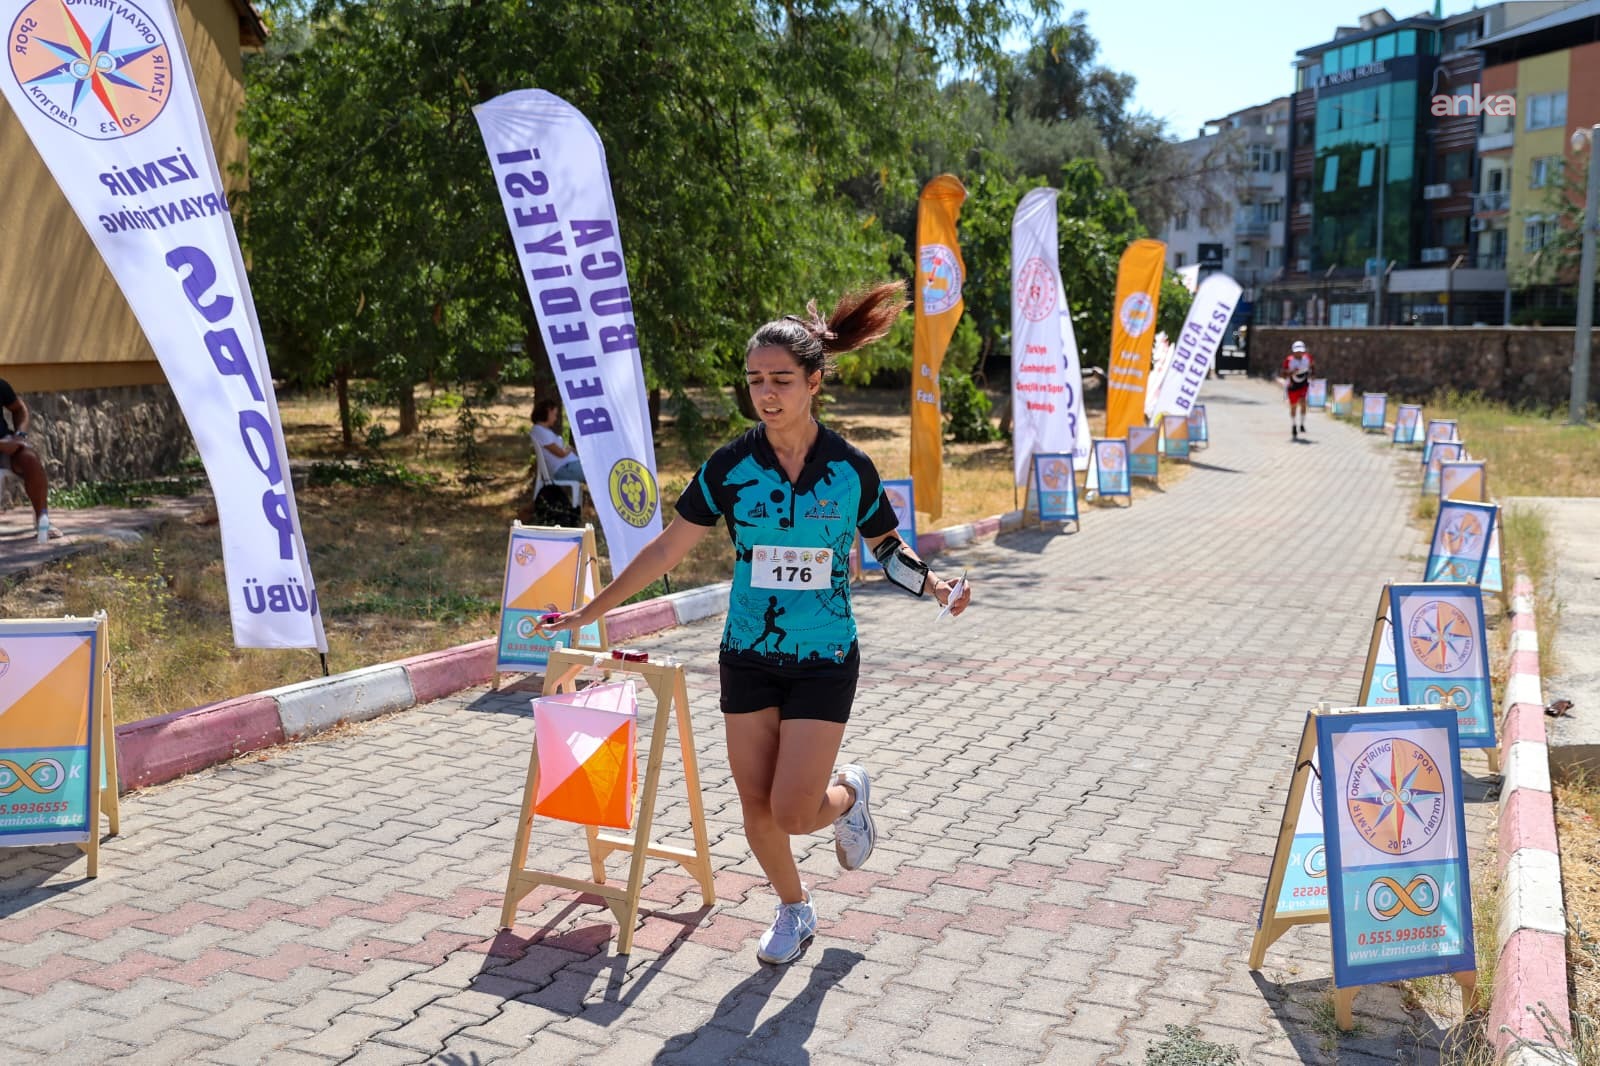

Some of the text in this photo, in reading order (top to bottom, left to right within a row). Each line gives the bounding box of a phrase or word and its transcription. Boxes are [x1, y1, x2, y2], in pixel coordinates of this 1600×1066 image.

[1172, 321, 1203, 374] BUCA
[772, 565, 812, 583] 176
[1412, 750, 1434, 775] SPOR
[0, 801, 69, 815] 5.9936555
[1357, 925, 1447, 946] 0.555.9936555
